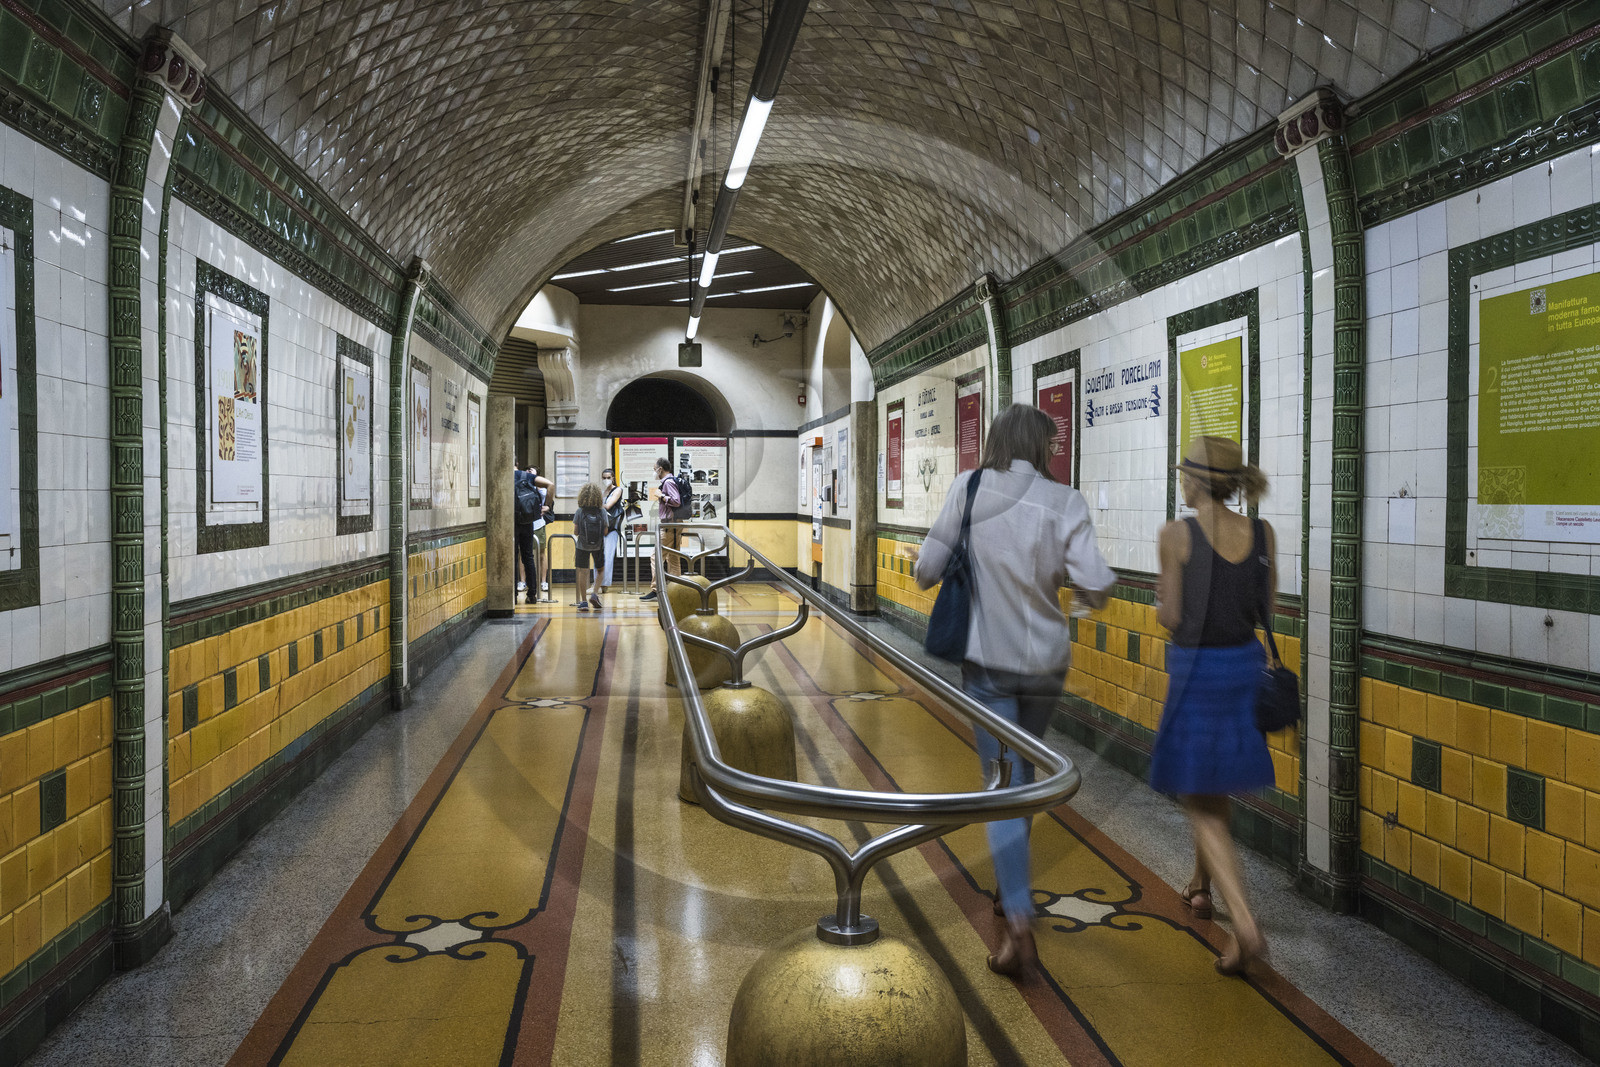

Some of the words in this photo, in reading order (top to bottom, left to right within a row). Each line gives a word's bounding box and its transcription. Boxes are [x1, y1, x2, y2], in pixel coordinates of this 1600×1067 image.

[1548, 297, 1588, 311] Manifattura
[1548, 309, 1579, 322] moderna
[1548, 324, 1554, 332] in
[1556, 321, 1572, 330] tutta
[1085, 372, 1115, 394] ISOLATORI
[1121, 359, 1161, 385] PORCELLANA
[1486, 366, 1498, 394] 2
[1094, 406, 1104, 417] ALTA
[1106, 406, 1108, 416] E
[1110, 402, 1123, 414] BASSA
[1126, 398, 1147, 412] TENSIONE
